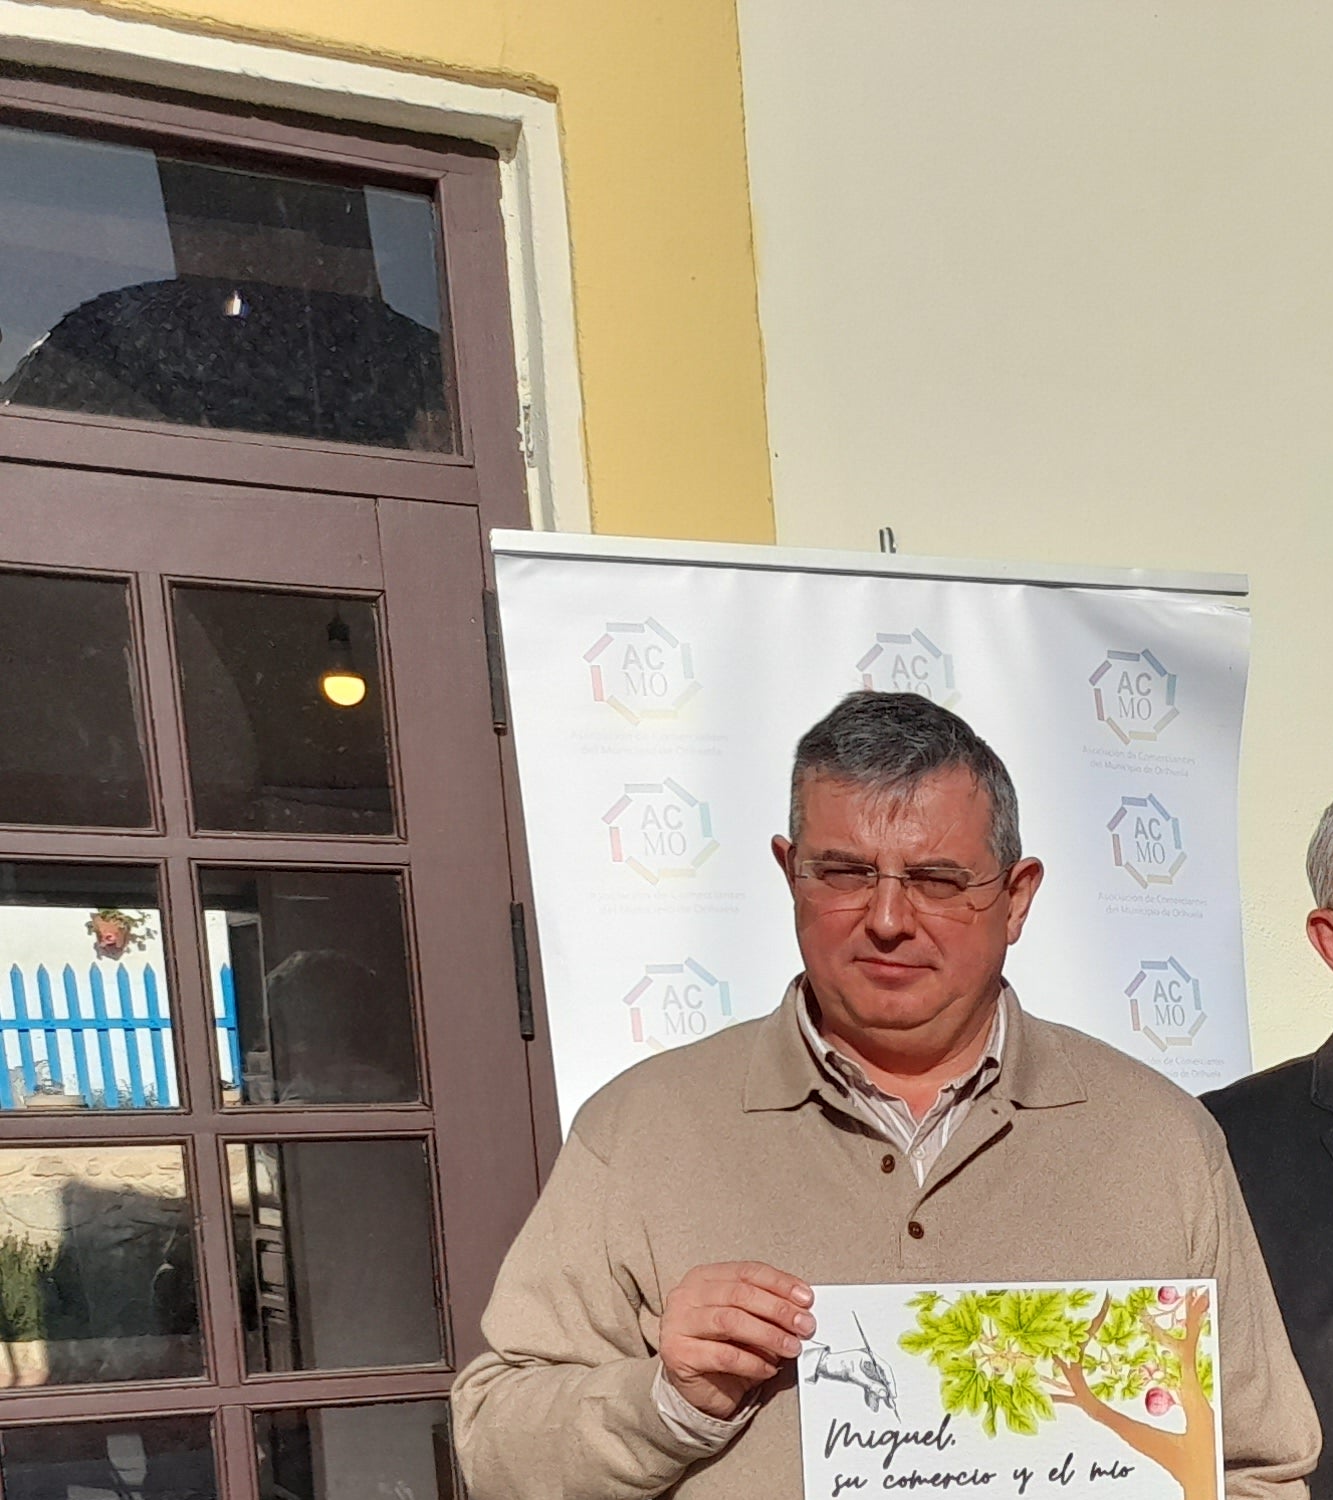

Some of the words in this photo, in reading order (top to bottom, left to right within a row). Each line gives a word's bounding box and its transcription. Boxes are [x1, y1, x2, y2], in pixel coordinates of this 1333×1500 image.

[622, 643, 665, 671] AC
[891, 654, 929, 680] AC
[624, 671, 668, 697] MO
[1117, 671, 1152, 697] AC
[1118, 695, 1153, 721] MO
[641, 804, 684, 830] AC
[1135, 817, 1162, 841] AC
[642, 831, 688, 857] MO
[1136, 840, 1166, 864] MO
[662, 983, 704, 1010] AC
[1153, 979, 1183, 1004] AC
[664, 1010, 707, 1036] MO
[1154, 1003, 1186, 1027] MO
[831, 1474, 868, 1498] su
[882, 1468, 997, 1490] comercio
[1012, 1467, 1034, 1495] y
[1048, 1452, 1076, 1486] el
